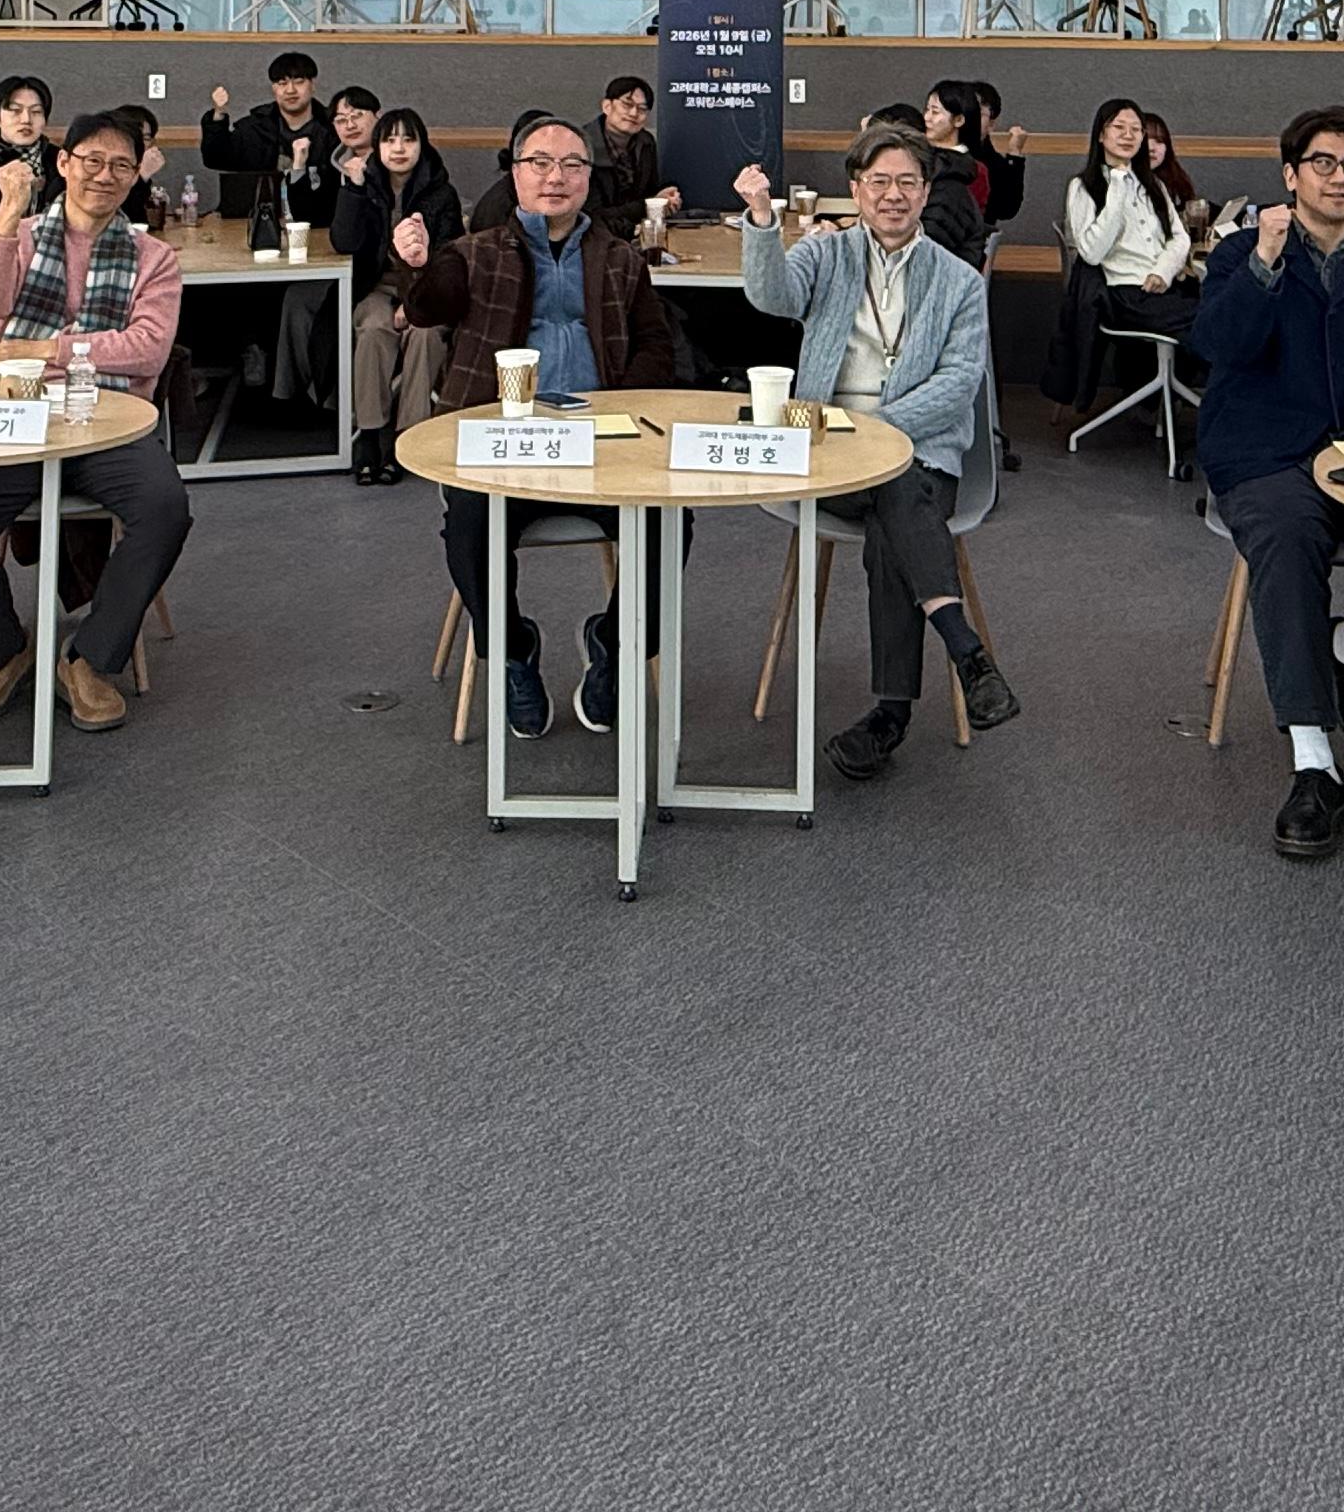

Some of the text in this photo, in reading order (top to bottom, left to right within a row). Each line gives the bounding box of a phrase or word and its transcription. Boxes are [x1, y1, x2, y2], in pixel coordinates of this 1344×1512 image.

[670, 29, 771, 43] 2026년 1월 9일 (금)
[695, 44, 743, 56] 오전 10시
[669, 82, 719, 94] 고려대학교
[685, 96, 755, 108] 코워킹스페이스
